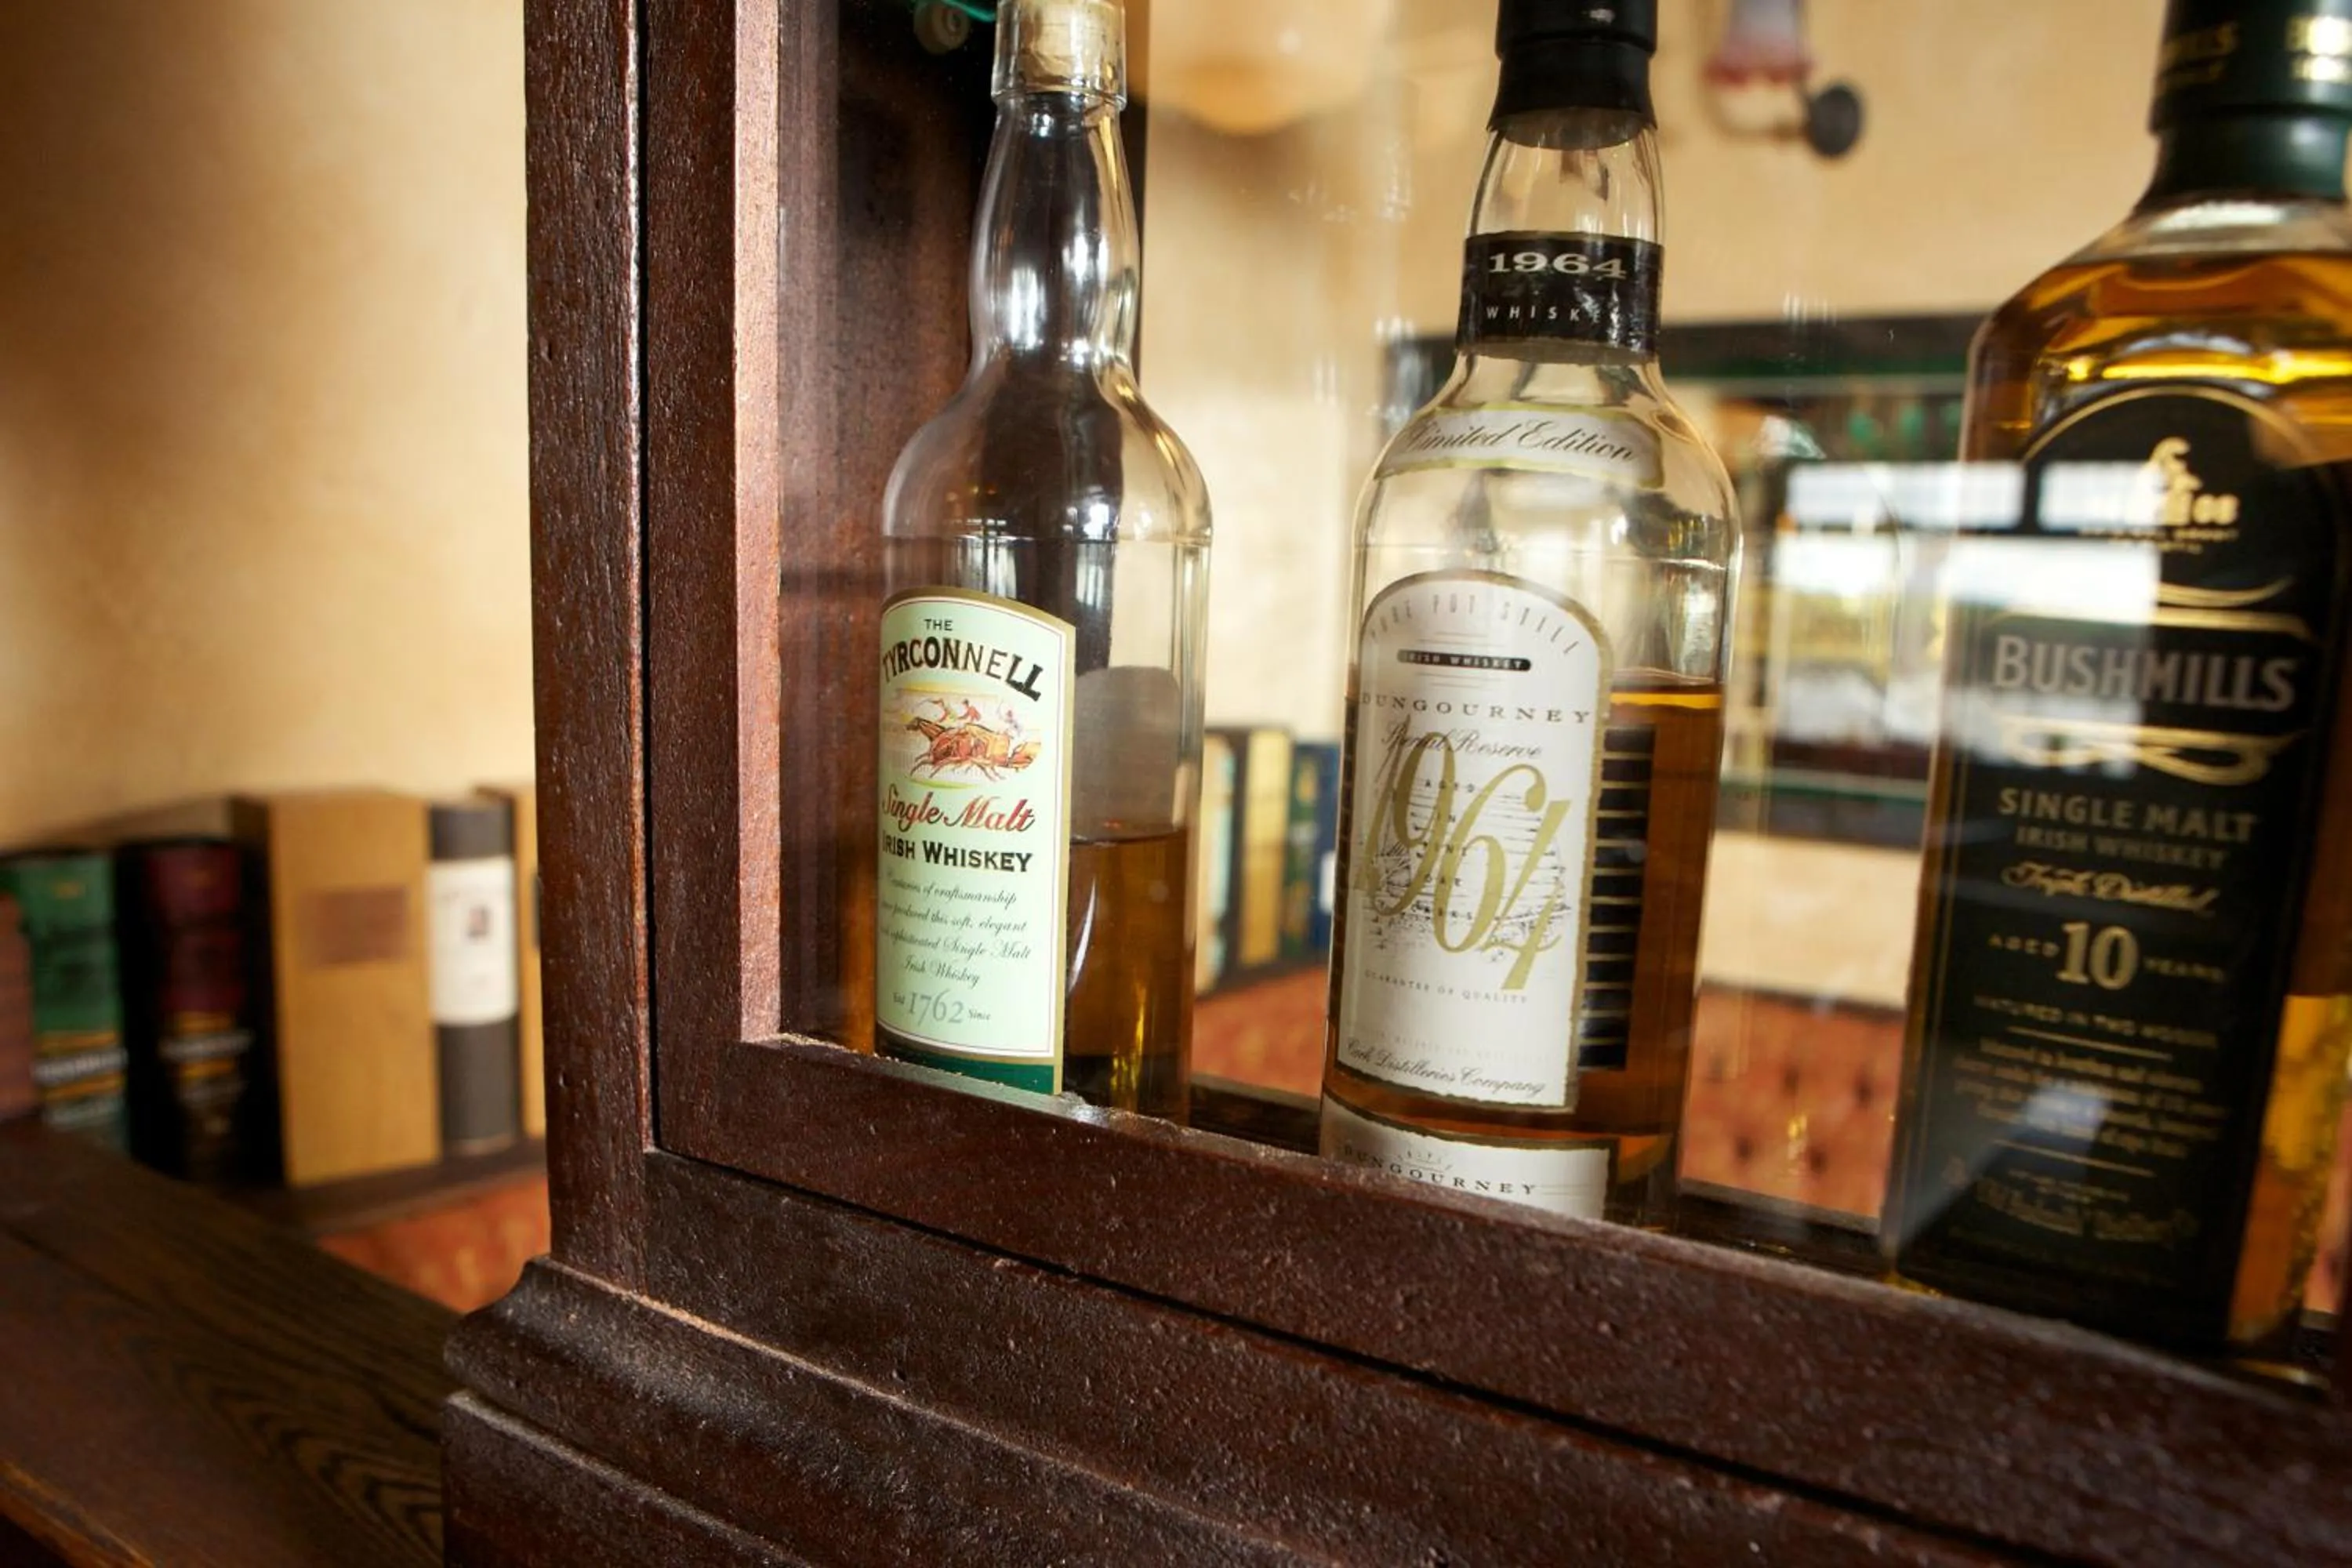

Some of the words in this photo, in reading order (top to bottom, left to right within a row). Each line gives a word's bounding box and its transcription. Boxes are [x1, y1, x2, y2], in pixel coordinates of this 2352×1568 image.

[1489, 252, 1627, 281] 1964
[1406, 419, 1522, 452] Limited
[1518, 419, 1633, 460] Edition
[924, 619, 953, 632] THE
[882, 636, 1044, 702] TYRCONNELL
[1450, 655, 1523, 670] WHISKEY
[1993, 633, 2297, 712] BUSHMILLS
[1361, 693, 1591, 724] DUNGOURNEY
[1446, 728, 1543, 759] Reserve
[882, 783, 944, 833] Single
[943, 794, 1036, 832] Malt
[1997, 786, 2135, 830] SINGLE
[2142, 801, 2259, 843] MALT
[921, 840, 1033, 873] WHISKEY
[1353, 714, 1573, 990] 1964
[2055, 921, 2140, 989] 10
[909, 987, 966, 1027] 1762
[1375, 1047, 1457, 1083] Distilleries
[1460, 1065, 1548, 1095] Company
[1344, 1146, 1536, 1196] DUNGOURNEY
